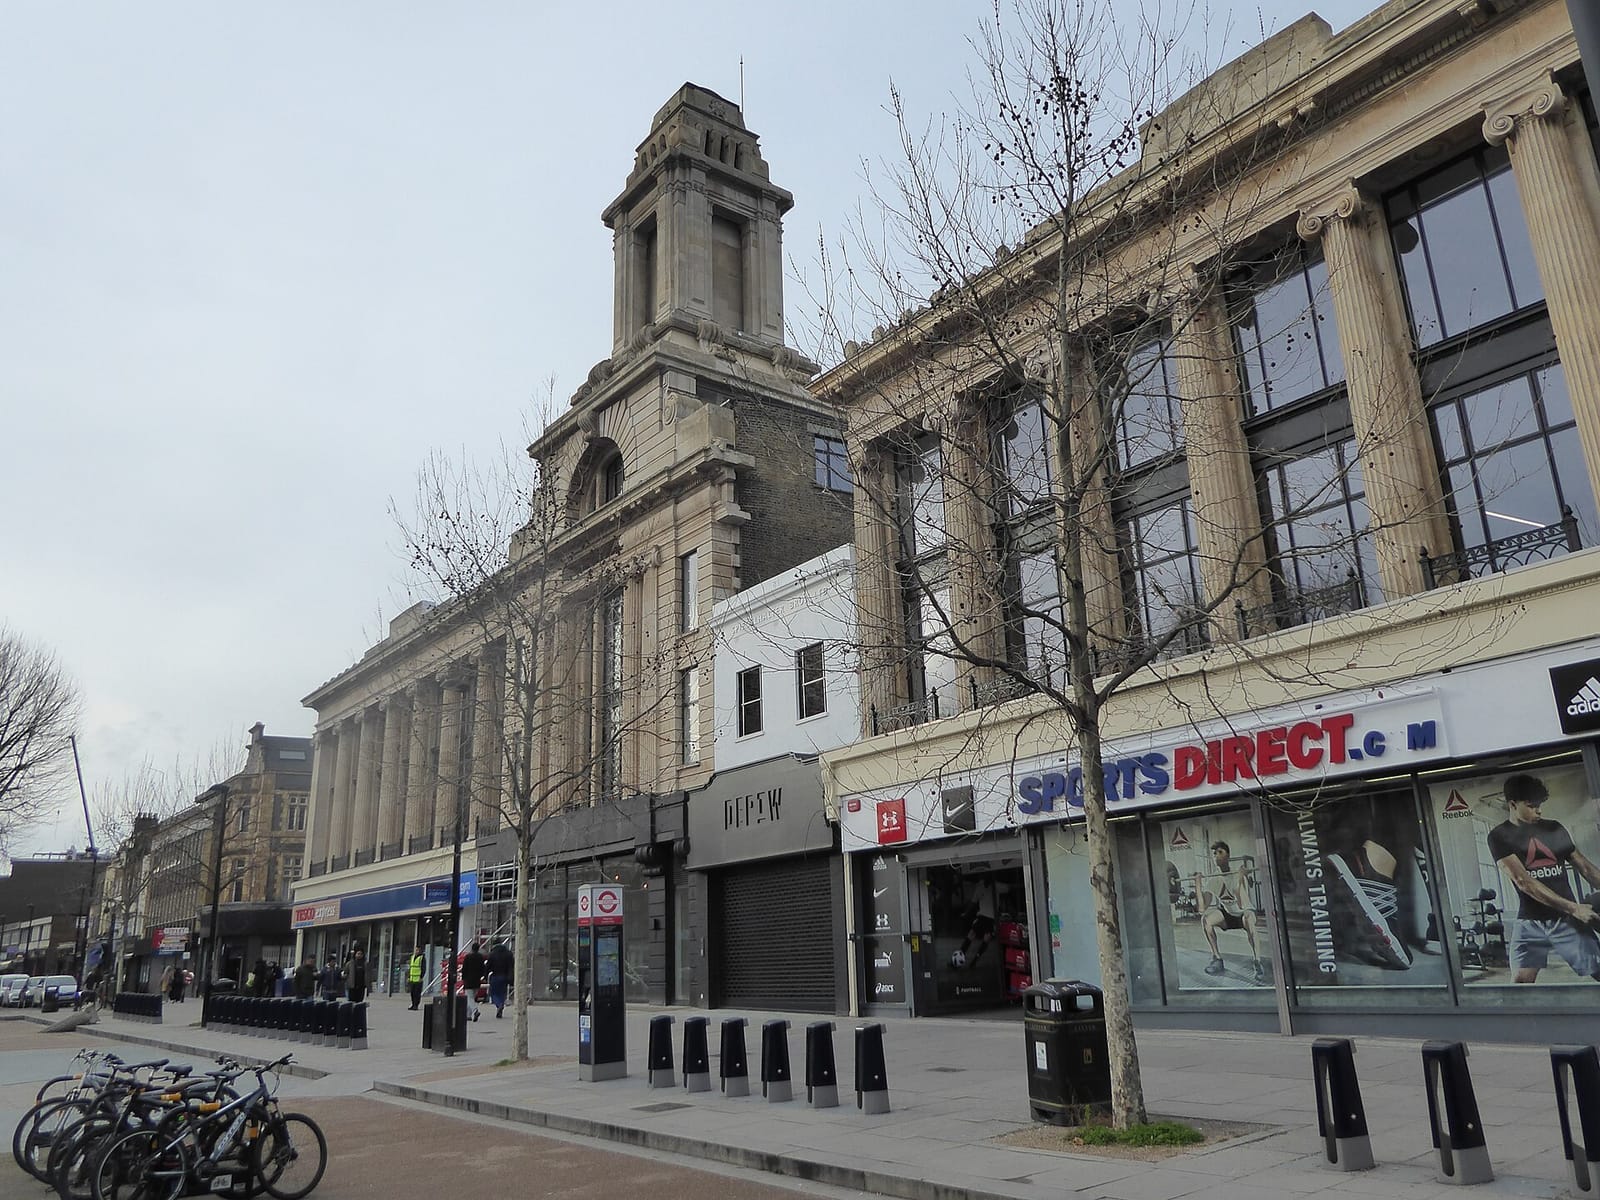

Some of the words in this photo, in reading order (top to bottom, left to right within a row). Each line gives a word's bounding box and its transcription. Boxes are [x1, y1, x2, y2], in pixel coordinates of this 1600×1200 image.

[1442, 809, 1474, 820] Reebok
[1297, 809, 1323, 879] ALWAYS
[295, 907, 314, 921] TESCO
[1308, 884, 1337, 973] TRAINING
